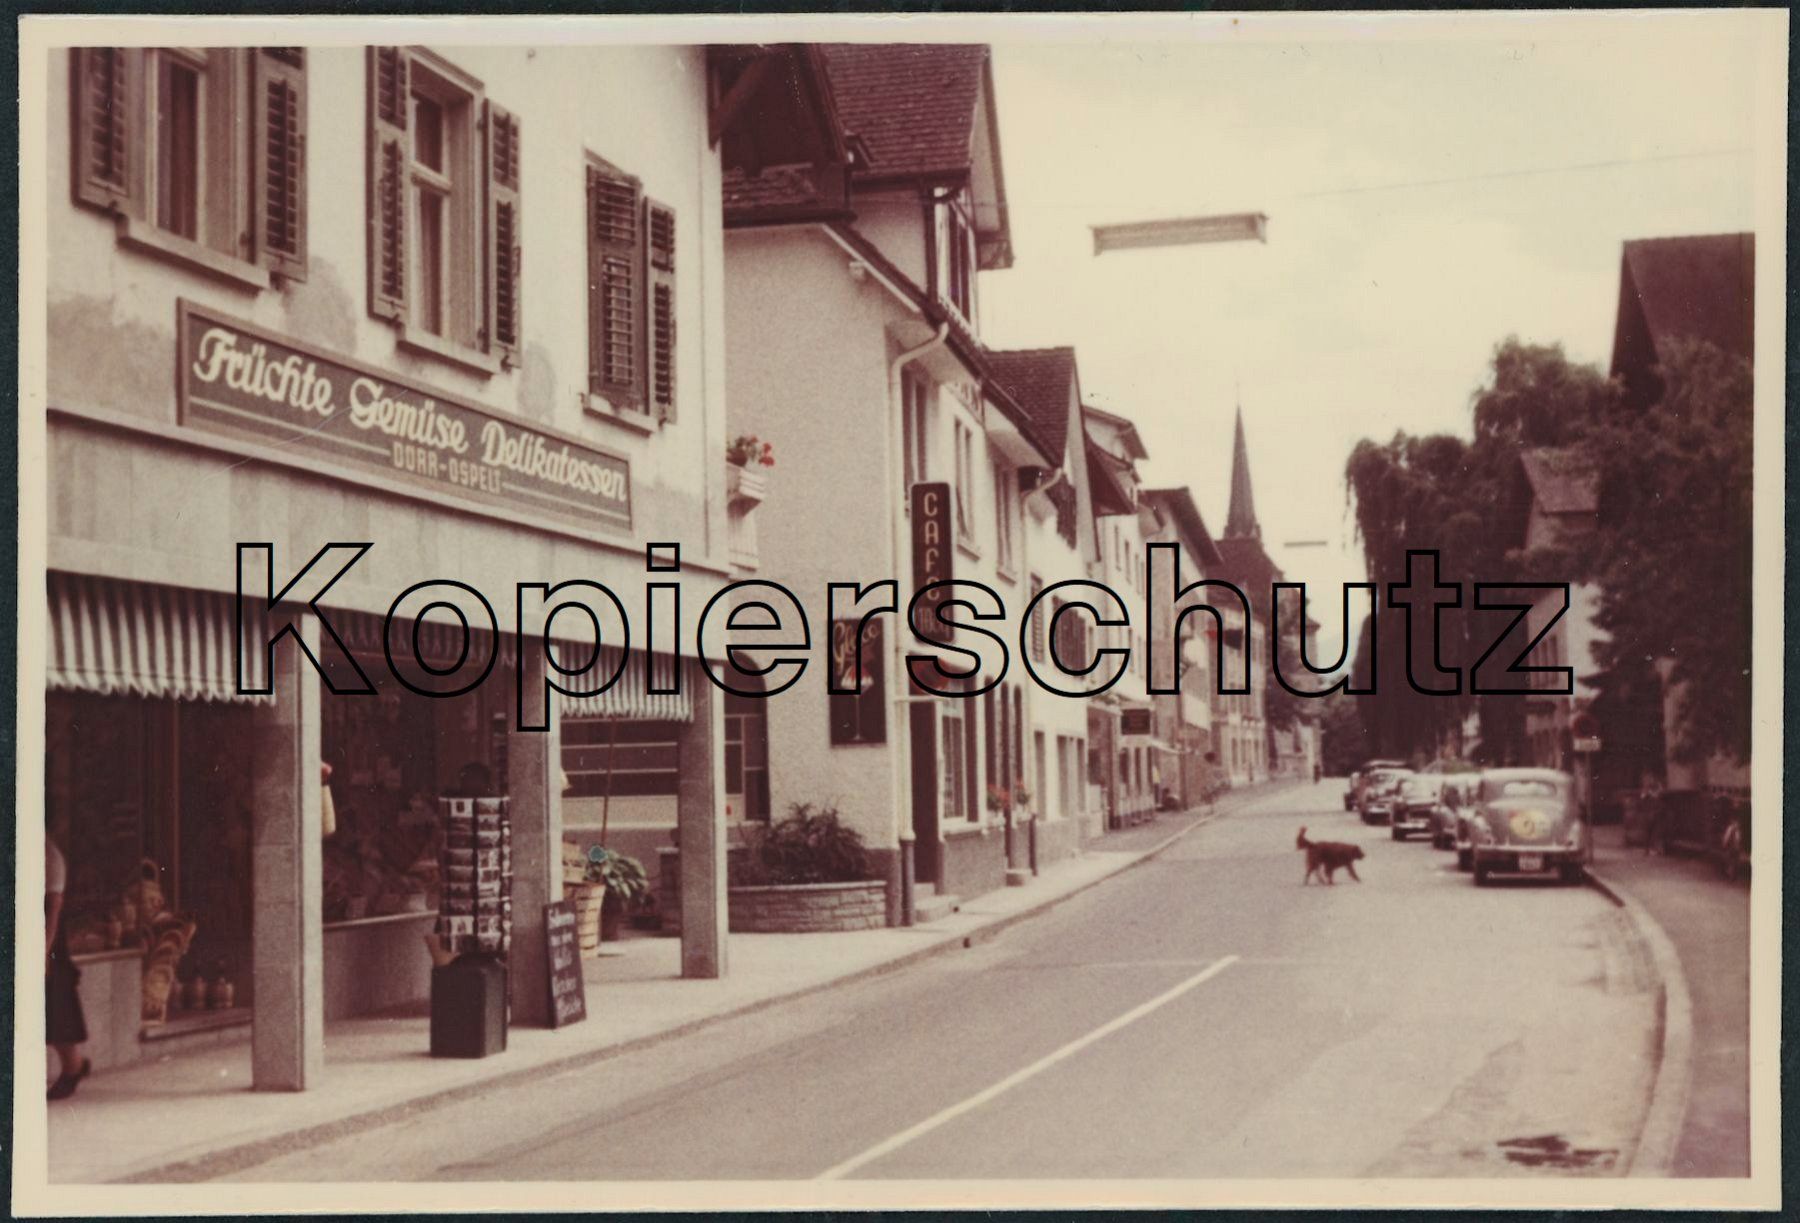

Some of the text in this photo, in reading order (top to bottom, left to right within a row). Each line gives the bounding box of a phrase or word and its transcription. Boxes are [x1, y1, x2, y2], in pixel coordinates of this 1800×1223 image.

[193, 328, 627, 502] Früchte Gemüse Delikatessen
